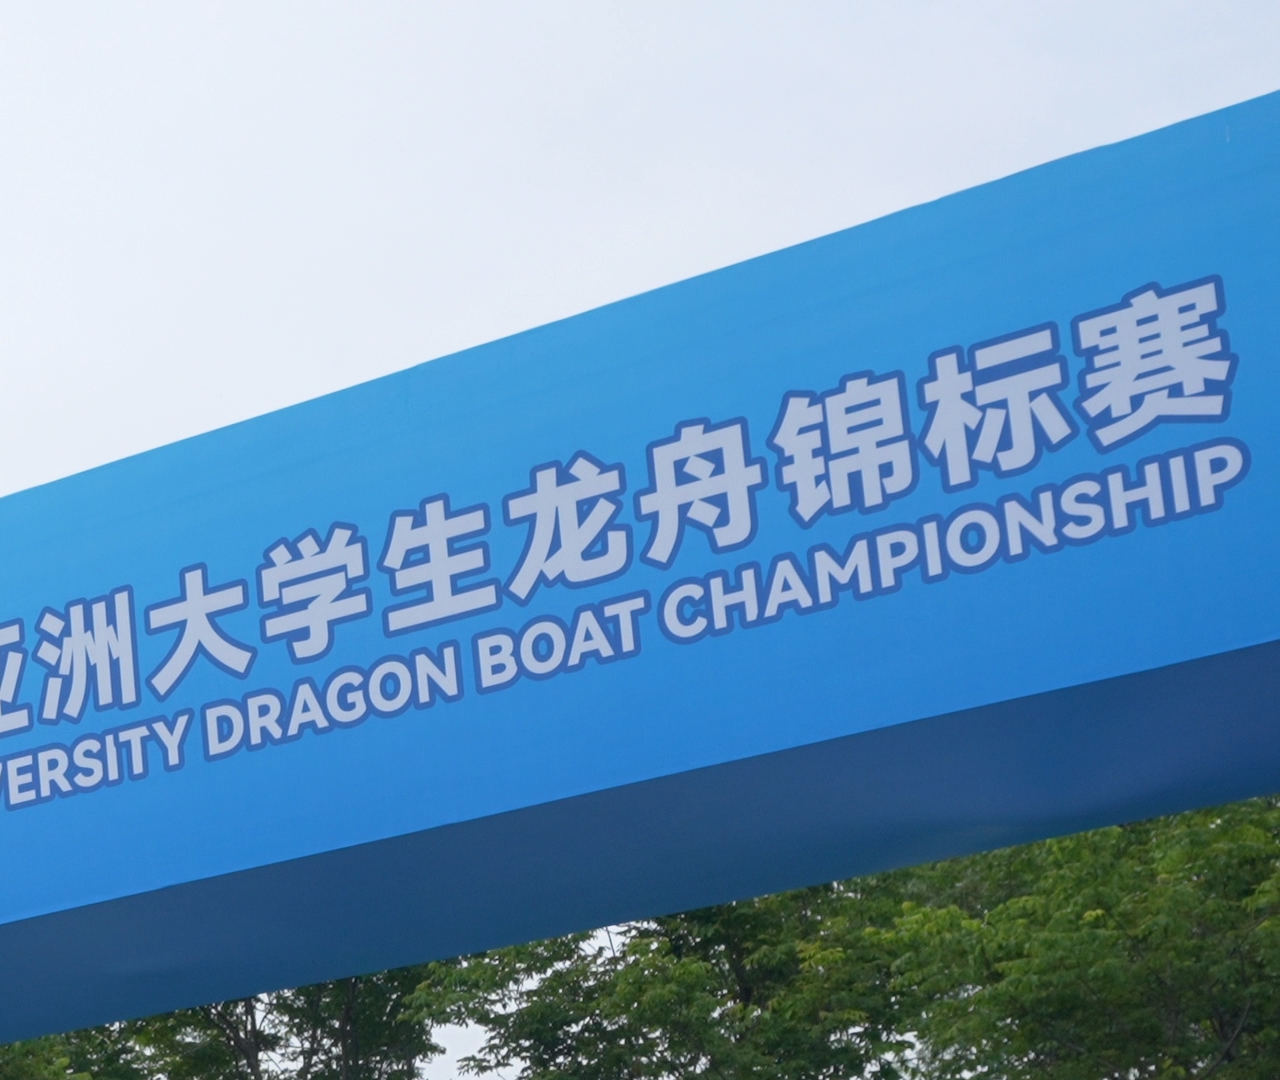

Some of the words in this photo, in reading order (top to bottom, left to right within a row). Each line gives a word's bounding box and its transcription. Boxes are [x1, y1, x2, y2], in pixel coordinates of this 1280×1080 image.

[206, 645, 456, 757] DRAGON
[476, 597, 645, 689] BOAT
[662, 443, 1243, 639] CHAMPIONSHIP
